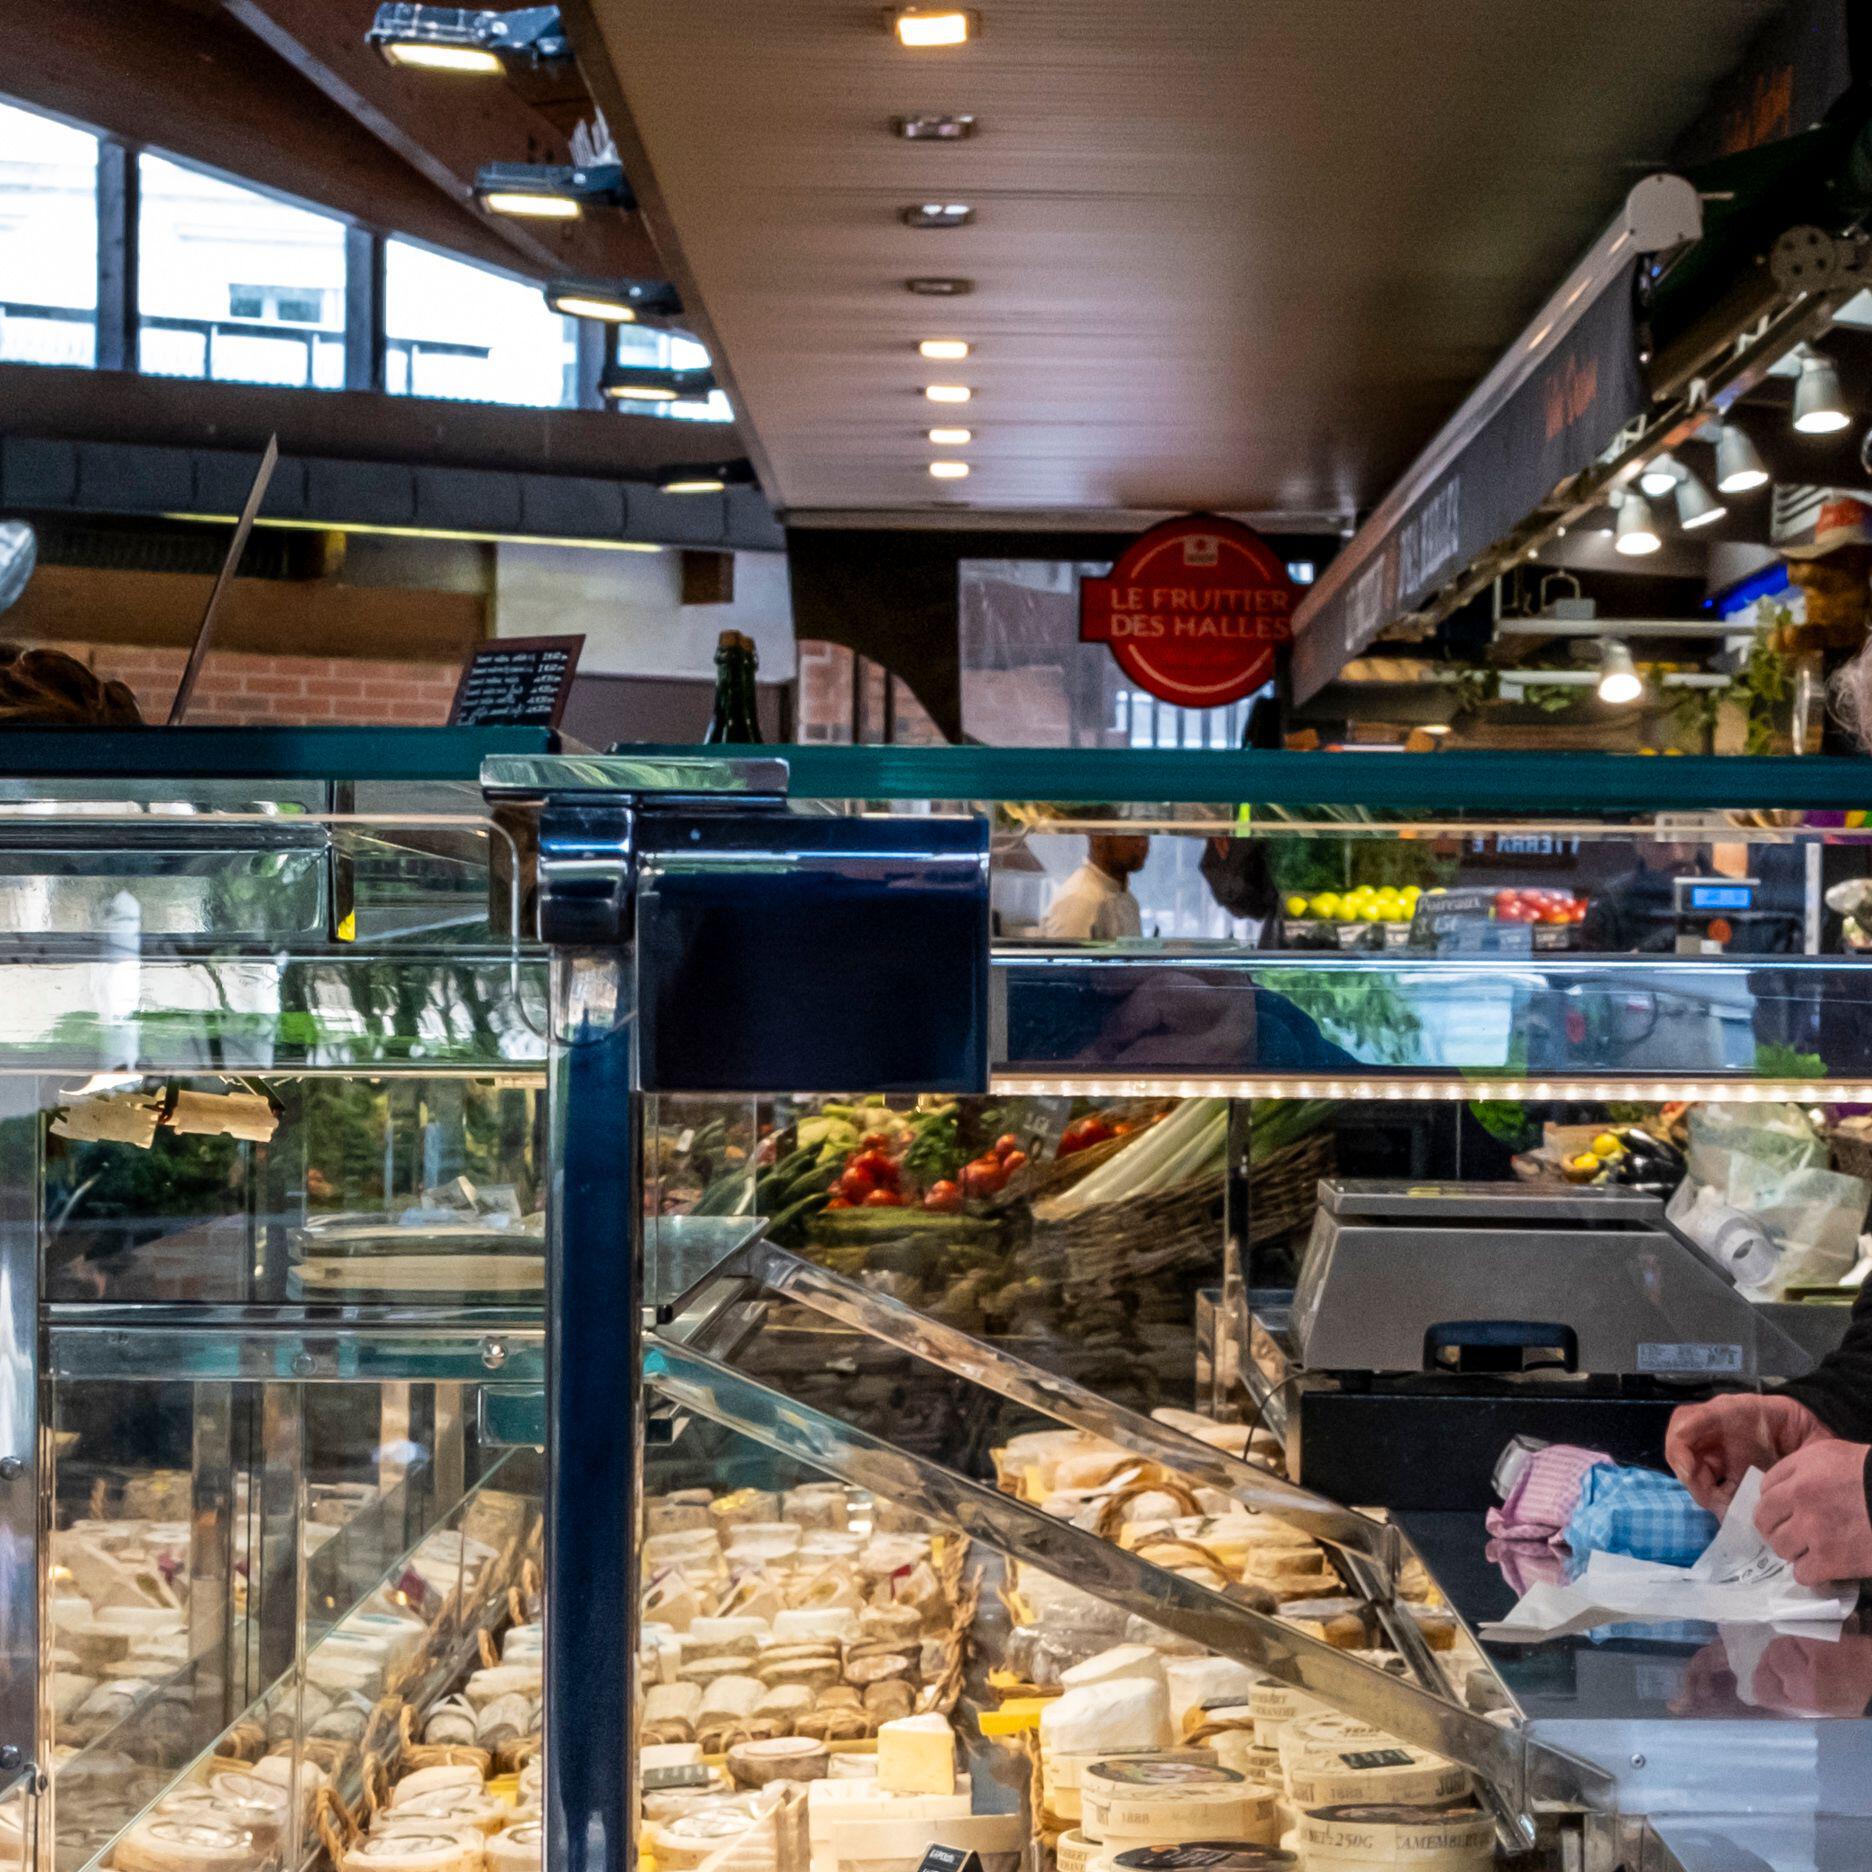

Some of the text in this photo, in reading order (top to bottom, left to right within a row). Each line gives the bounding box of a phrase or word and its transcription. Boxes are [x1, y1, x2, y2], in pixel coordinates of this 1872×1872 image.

[1111, 588, 1290, 611] LE FRUITIER
[1110, 614, 1292, 640] DES HALLES
